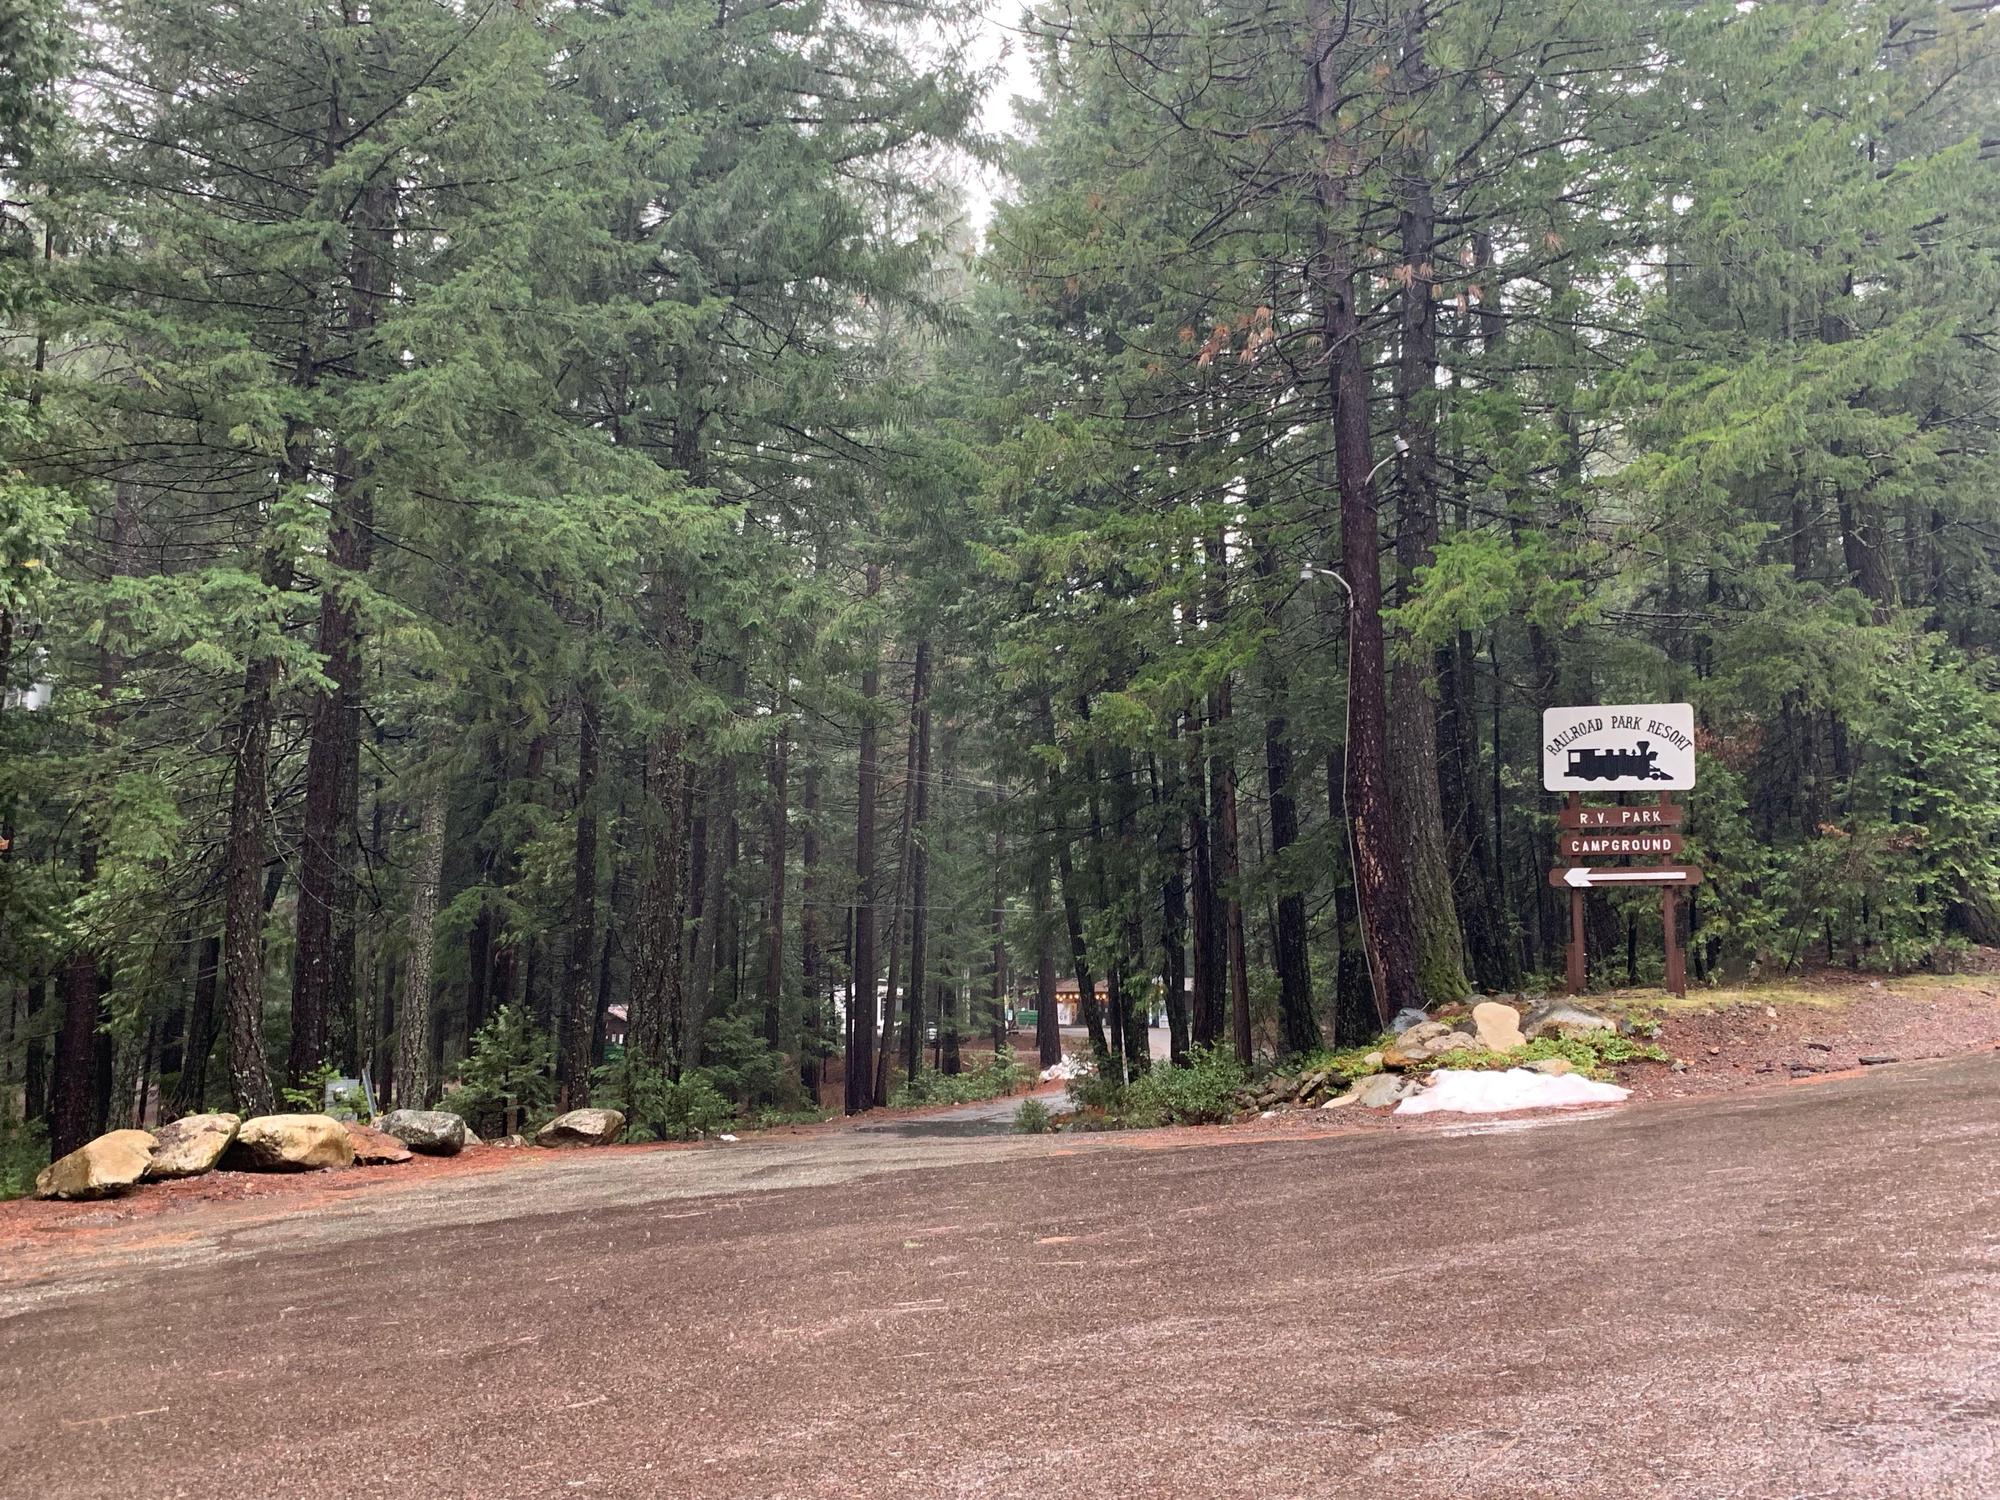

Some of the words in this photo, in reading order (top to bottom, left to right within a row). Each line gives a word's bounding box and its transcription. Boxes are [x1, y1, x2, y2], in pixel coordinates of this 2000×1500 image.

[1546, 718, 1603, 756] RAILROAD
[1611, 716, 1643, 730] PARK
[1647, 720, 1693, 751] RESORT
[1580, 813, 1609, 824] R.V.
[1622, 811, 1661, 823] PARK
[1571, 839, 1671, 852] CAMPGROUND
